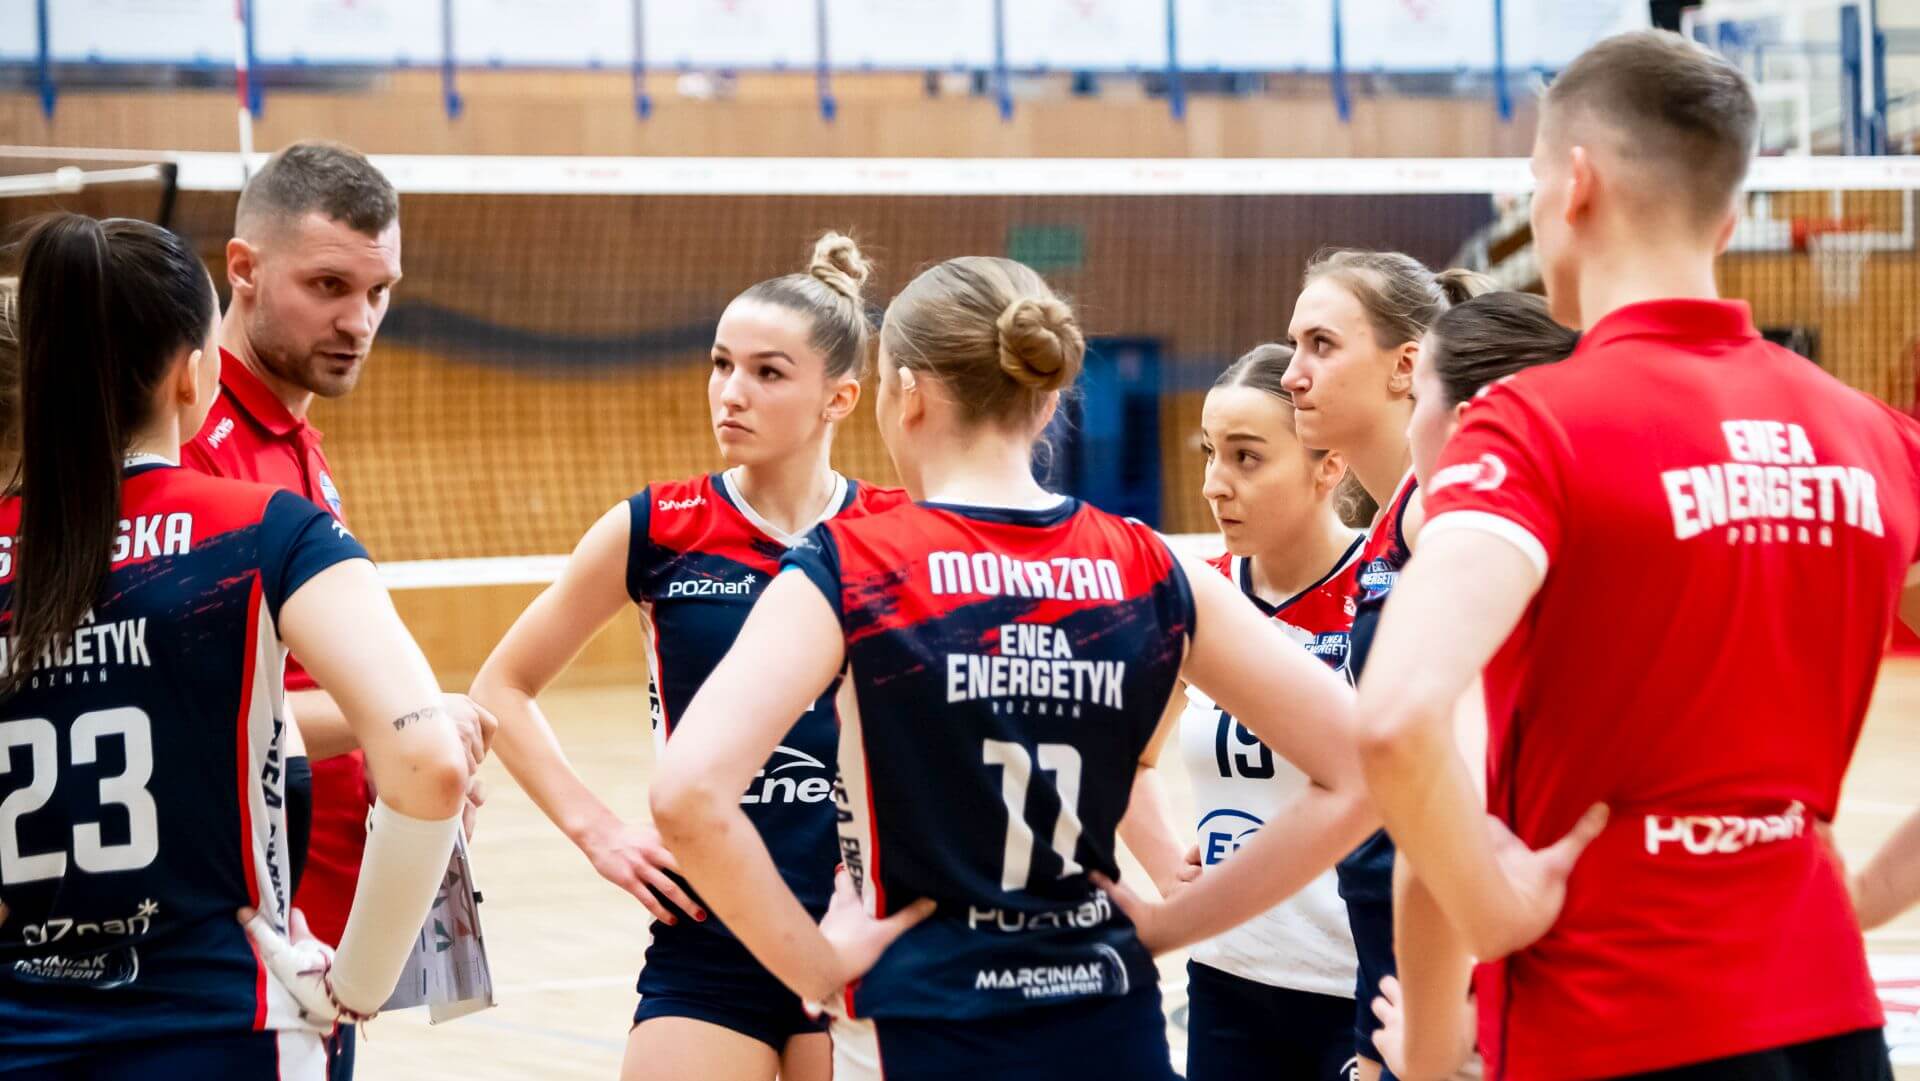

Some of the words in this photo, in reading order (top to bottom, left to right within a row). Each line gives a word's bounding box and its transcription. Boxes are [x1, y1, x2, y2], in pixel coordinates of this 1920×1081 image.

[1721, 419, 1816, 464] ENEA
[1661, 463, 1885, 540] ENERGETYK
[928, 551, 1124, 601] MOKRZAN
[1001, 623, 1073, 659] ENEA
[947, 653, 1125, 710] ENERGETYK
[0, 706, 159, 884] 23
[975, 963, 1102, 990] MARCINIAK
[1022, 981, 1104, 998] TRANSPORT
